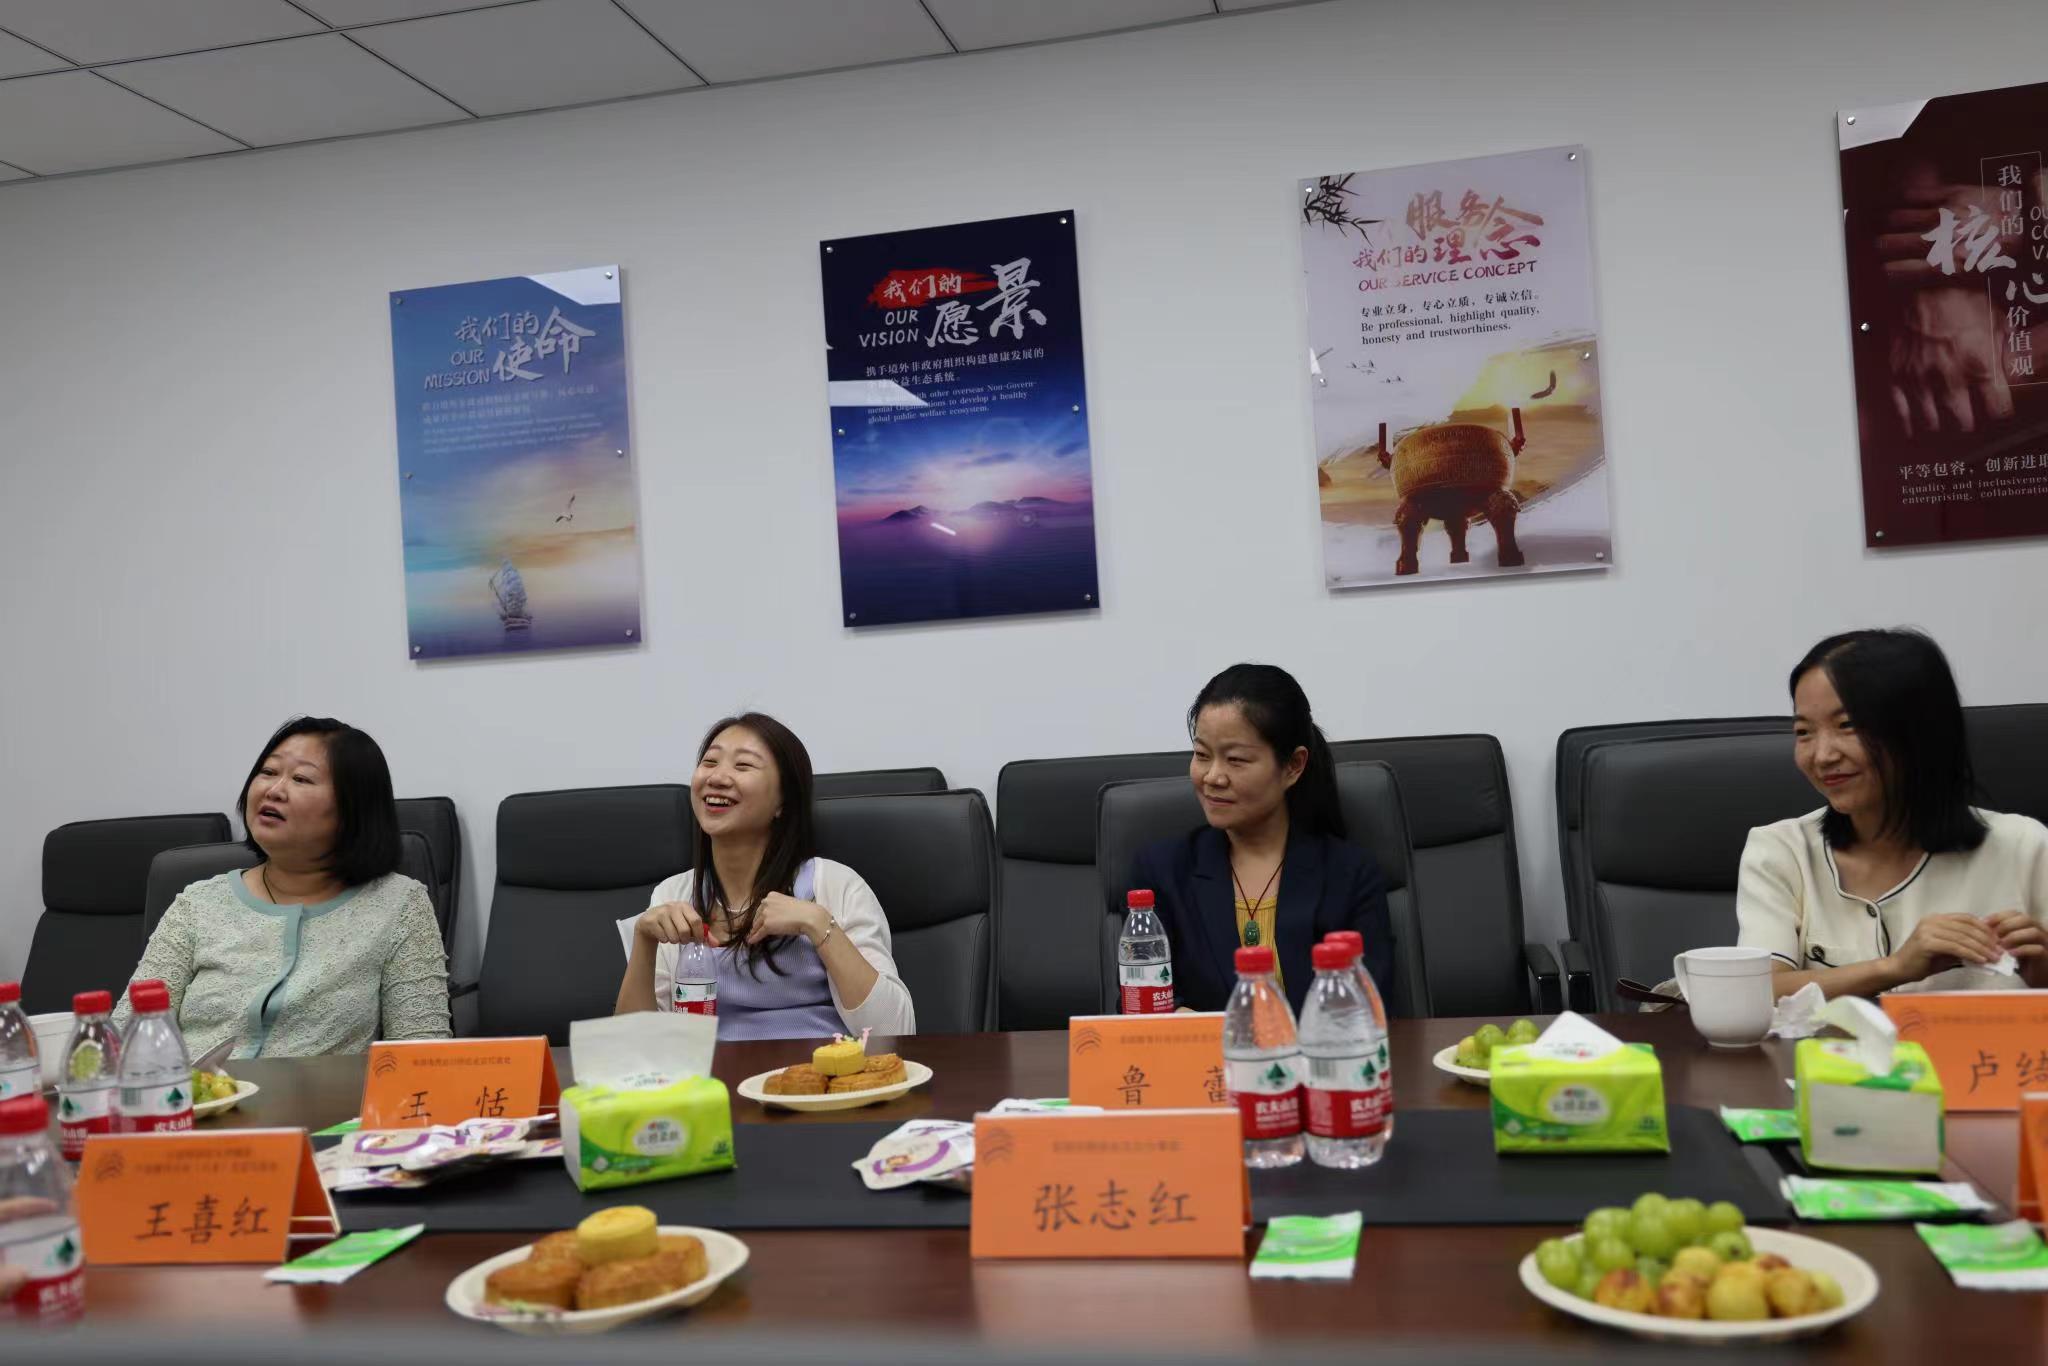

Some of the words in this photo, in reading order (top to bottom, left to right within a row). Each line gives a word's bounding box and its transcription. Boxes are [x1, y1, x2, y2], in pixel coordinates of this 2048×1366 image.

[1998, 164, 2024, 236] 我们的
[1358, 278, 1387, 292] OUR
[1463, 260, 1537, 280] CONCEPT
[883, 273, 962, 303] 我们的
[925, 257, 1047, 348] 愿景
[455, 312, 540, 345] 我们的
[885, 309, 918, 326] OUR
[1361, 322, 1374, 332] Be
[1450, 309, 1495, 324] highlight
[493, 306, 596, 381] 使命
[859, 328, 919, 348] VISION
[1362, 333, 1401, 345] honesty
[1406, 330, 1424, 341] and
[1430, 324, 1511, 338] trustworthiness.
[2006, 306, 2034, 377] 价值观
[451, 348, 485, 366] OUR
[424, 368, 491, 390] MISSION
[930, 388, 950, 398] other
[953, 385, 984, 396] overseas
[950, 398, 957, 406] to
[960, 394, 988, 405] develop
[1000, 391, 1028, 401] healthy
[868, 414, 890, 424] global
[894, 412, 917, 422] public
[920, 409, 947, 418] welfare
[950, 405, 990, 416] ecosystem.
[1902, 482, 1946, 496] Equality
[1953, 480, 1972, 490] and
[1034, 1180, 1197, 1232] 张志红
[134, 1193, 269, 1244] 王喜红
